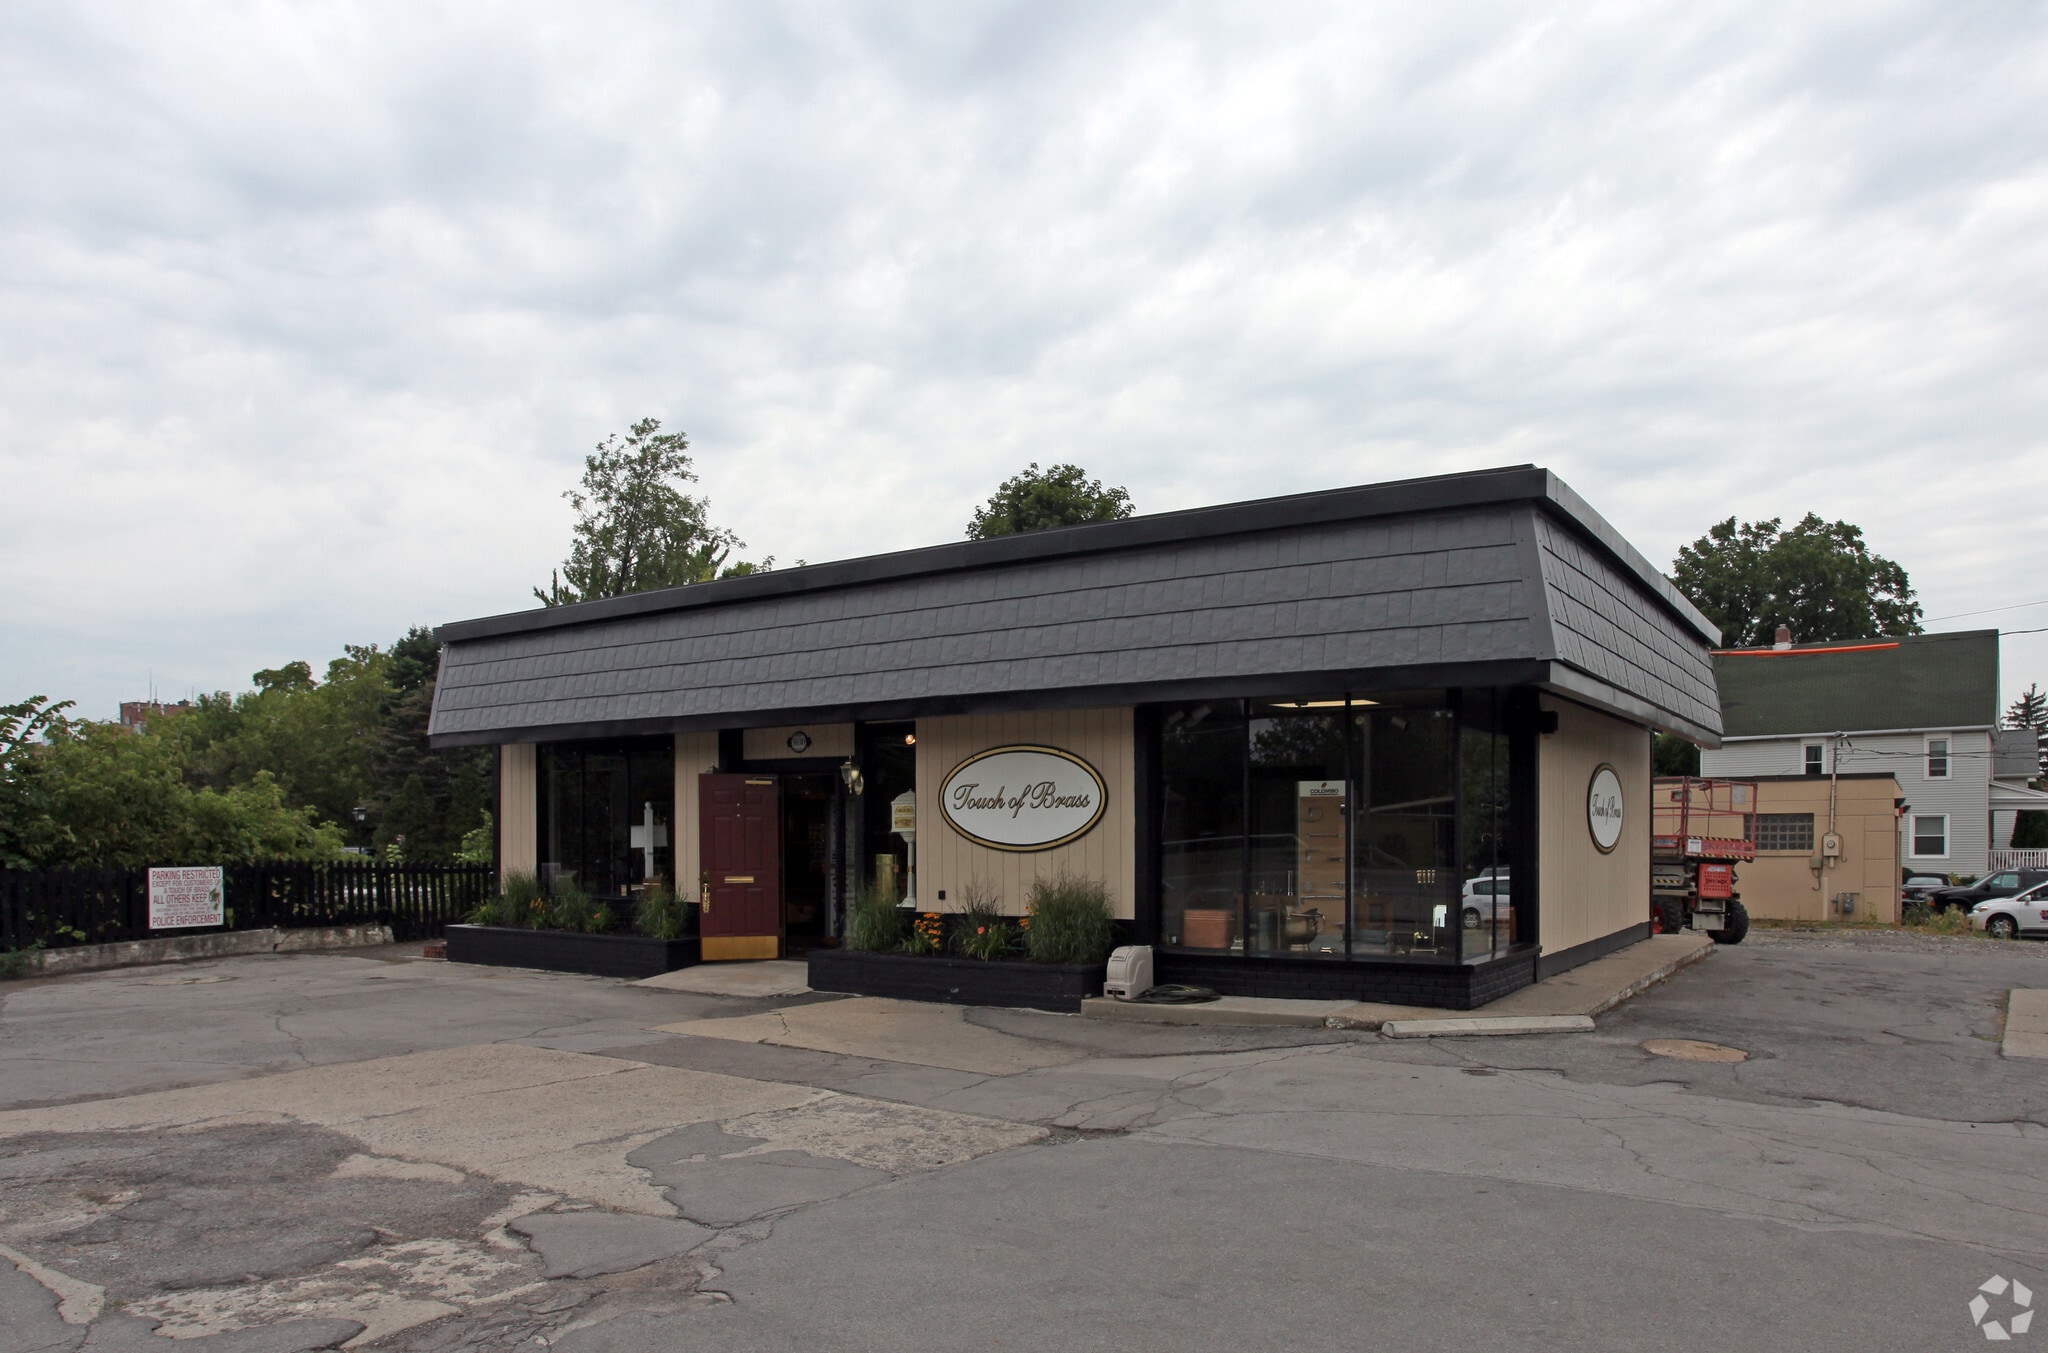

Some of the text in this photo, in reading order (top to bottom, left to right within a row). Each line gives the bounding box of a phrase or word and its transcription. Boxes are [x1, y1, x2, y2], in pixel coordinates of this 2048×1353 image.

[953, 781, 1090, 818] Touch of Brass
[152, 870, 221, 881] PARKING RESTRICTED
[183, 879, 213, 887] CUSTOMERS
[153, 895, 165, 905] ALL
[166, 894, 190, 904] OTHERS
[191, 893, 207, 903] KEEP
[152, 914, 221, 927] POLICE ENFORCEMENT
